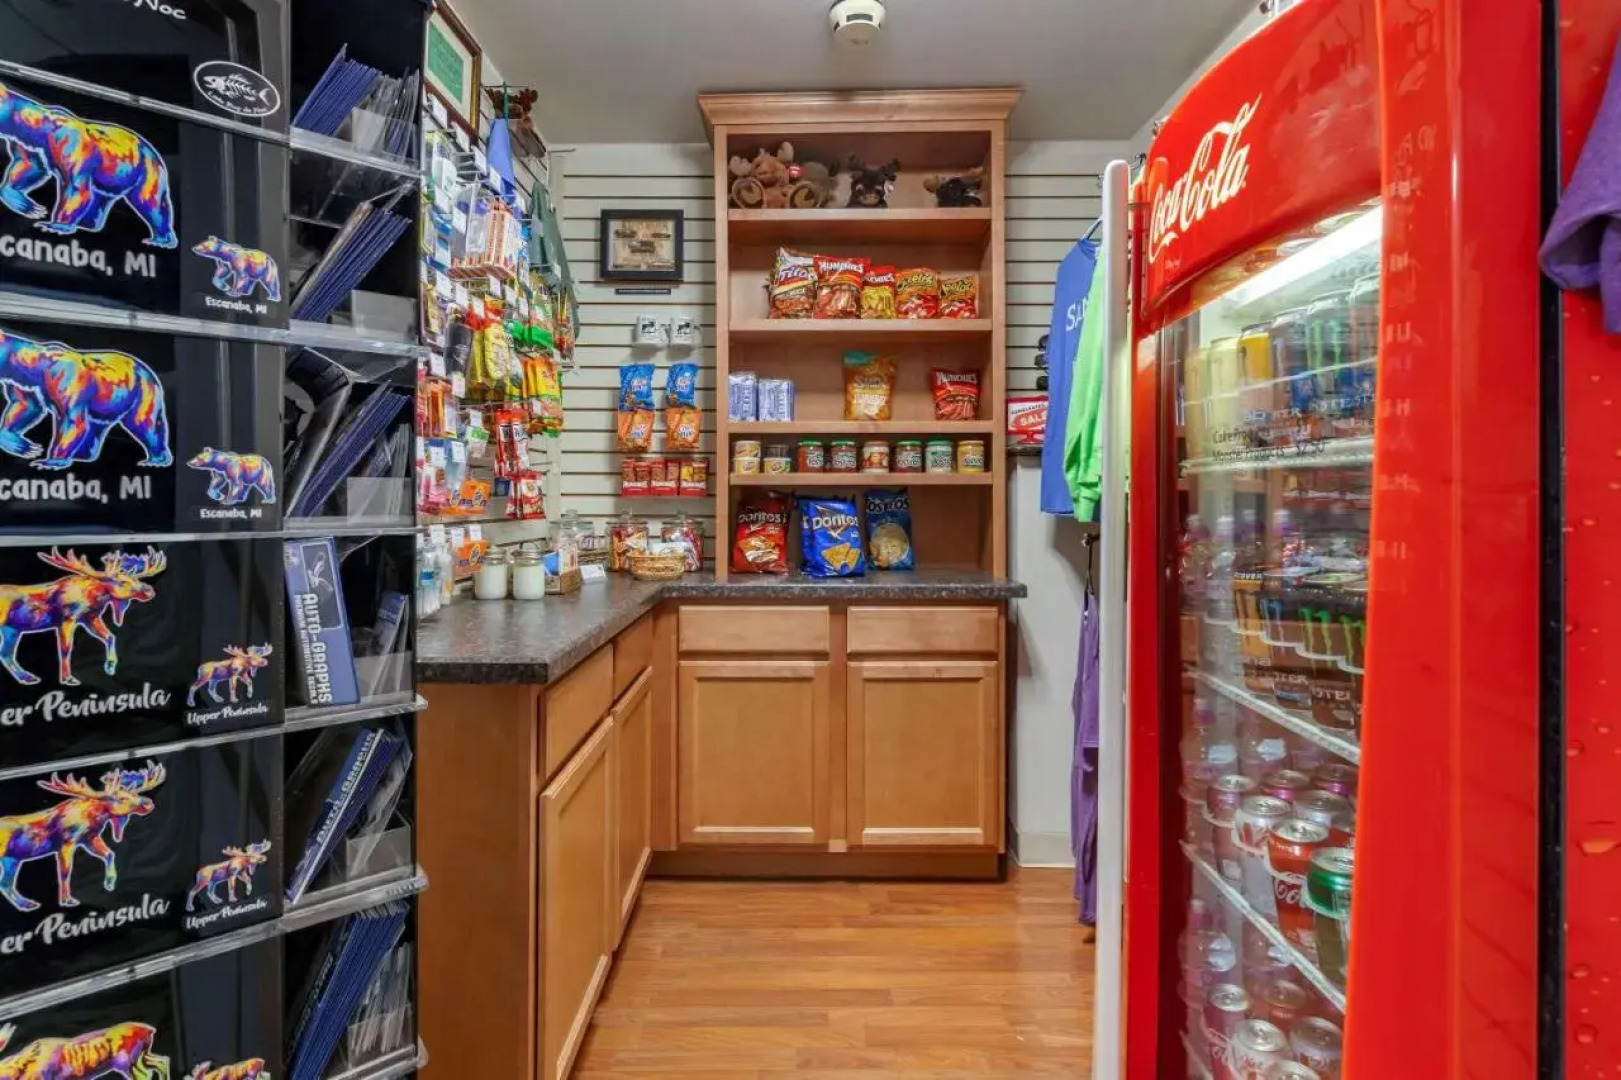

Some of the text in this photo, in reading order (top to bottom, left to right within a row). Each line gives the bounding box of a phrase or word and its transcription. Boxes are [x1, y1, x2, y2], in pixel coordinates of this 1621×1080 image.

[1149, 92, 1263, 264] Coca-Cola
[124, 252, 157, 278] MI
[205, 296, 268, 315] Escanaba, MI
[119, 476, 151, 500] MI
[200, 508, 262, 519] Escanaba, MI
[1, 682, 171, 725] er Peninsula
[187, 702, 268, 725] Upper Peninsula
[0, 893, 170, 955] er Peninsula
[186, 898, 267, 929] Upper Peninsula
